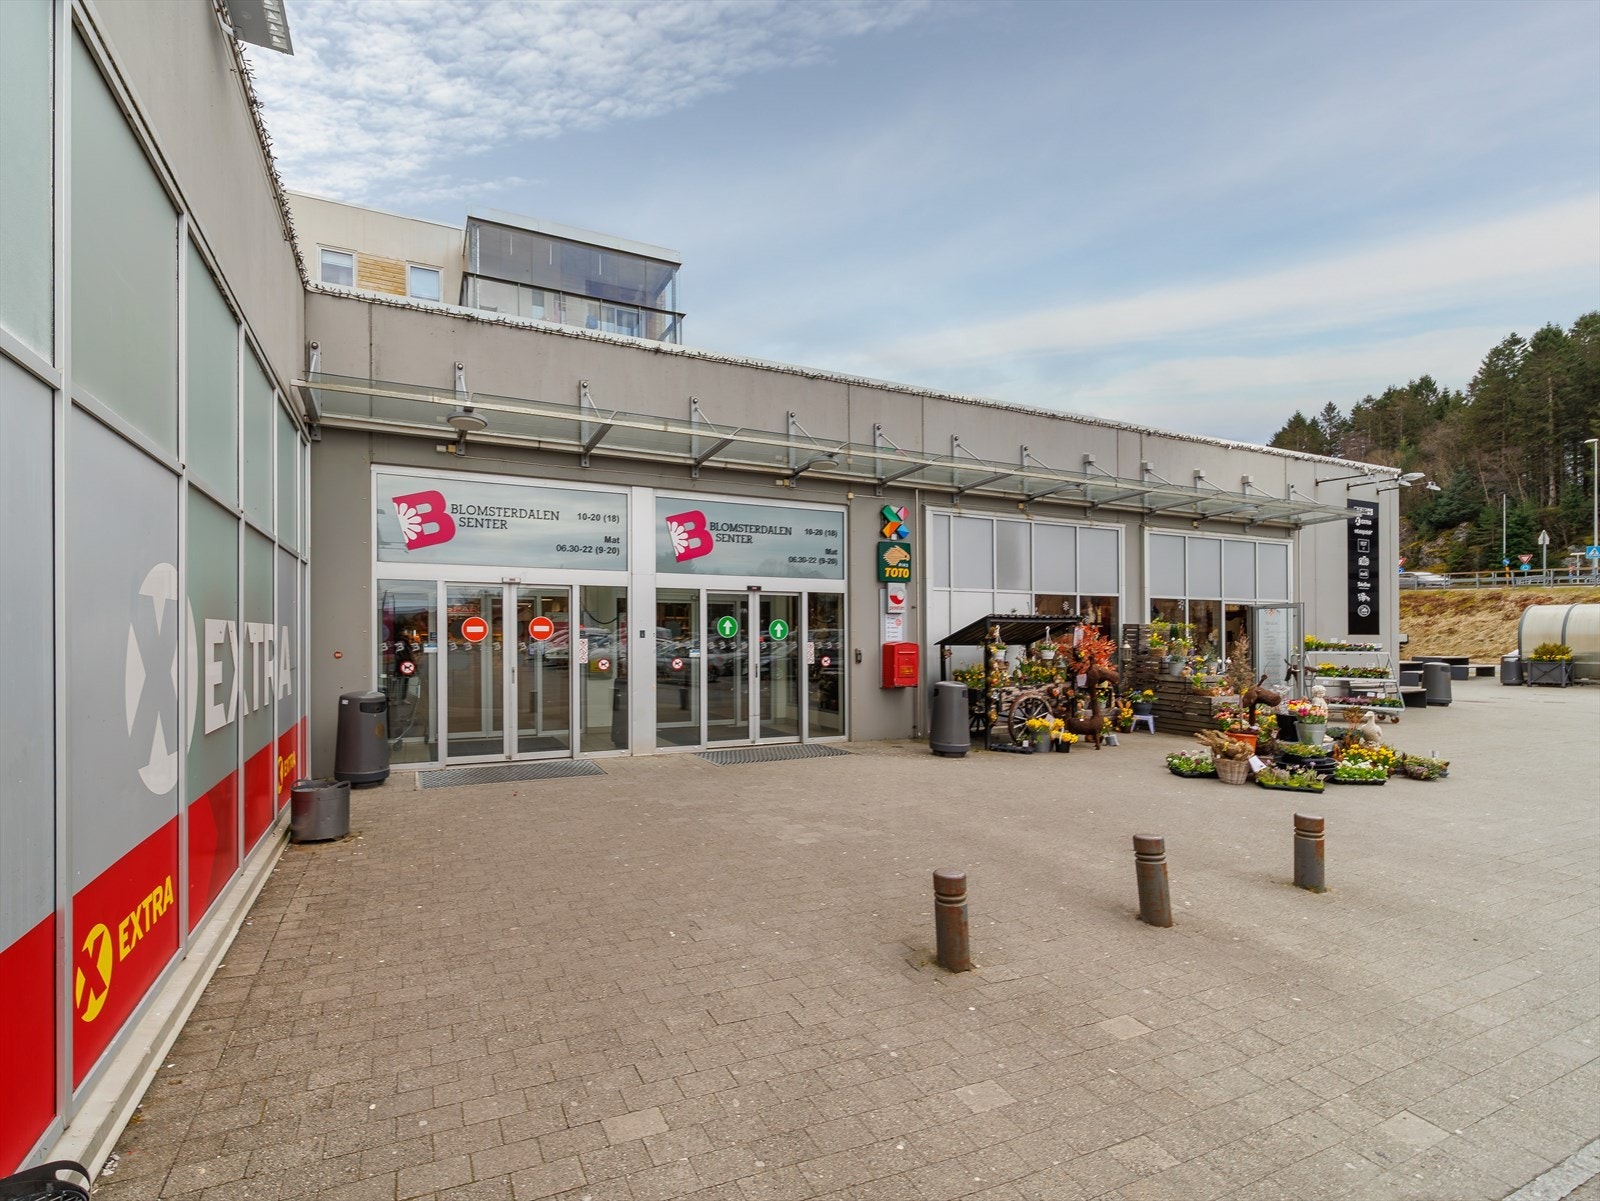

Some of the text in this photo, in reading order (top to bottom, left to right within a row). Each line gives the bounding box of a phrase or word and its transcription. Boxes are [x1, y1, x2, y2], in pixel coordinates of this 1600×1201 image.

[450, 503, 560, 521] BLOMSTERDALEN
[458, 517, 508, 530] SENTER
[577, 513, 620, 524] 10-20 (18)
[709, 522, 792, 535] BLOMSTERDALEN
[604, 535, 620, 544] Mat
[716, 533, 753, 544] SENTER
[556, 544, 620, 556] 06.30-22 (9-20)
[885, 567, 910, 578] TOTO
[204, 618, 292, 735] EXTRA
[118, 875, 174, 962] EXTRA
